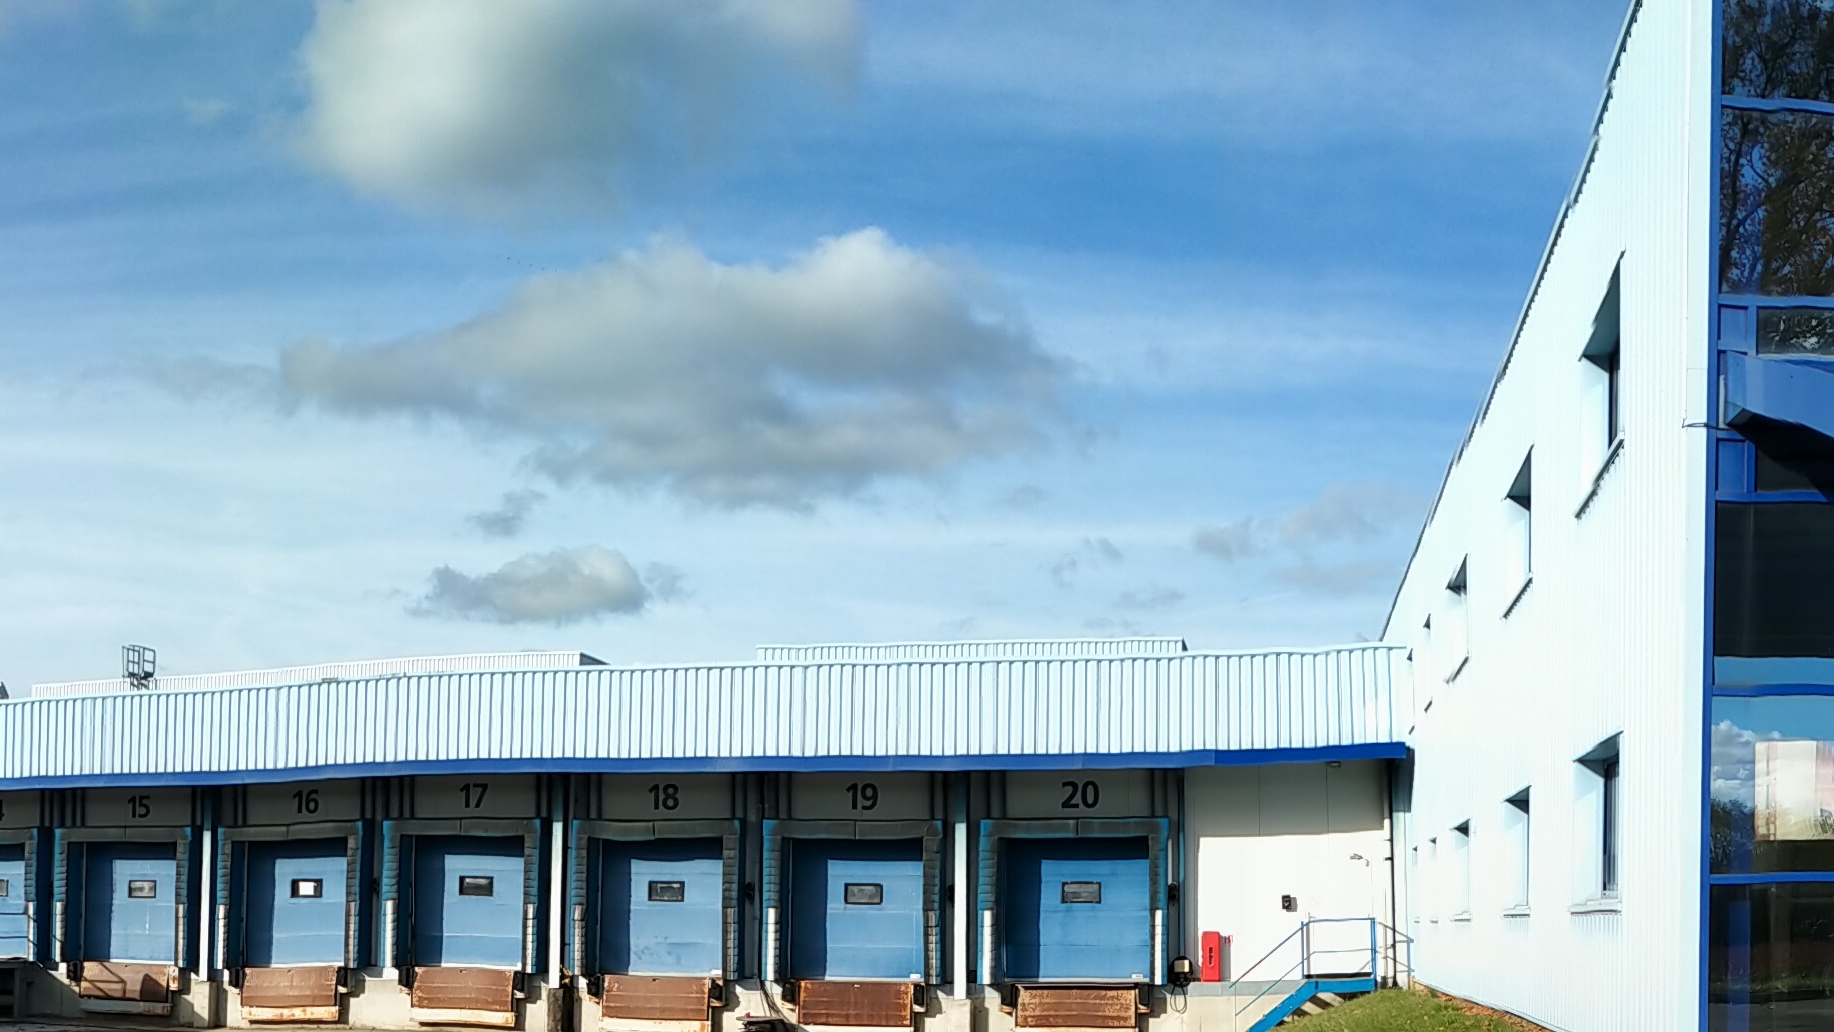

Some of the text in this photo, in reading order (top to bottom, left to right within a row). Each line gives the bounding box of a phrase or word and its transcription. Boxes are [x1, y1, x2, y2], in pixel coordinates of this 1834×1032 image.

[127, 795, 151, 819] 15
[292, 789, 319, 814] 16
[459, 783, 488, 809] 17
[648, 783, 680, 811] 18
[845, 783, 879, 811] 19
[1061, 781, 1100, 809] 20
